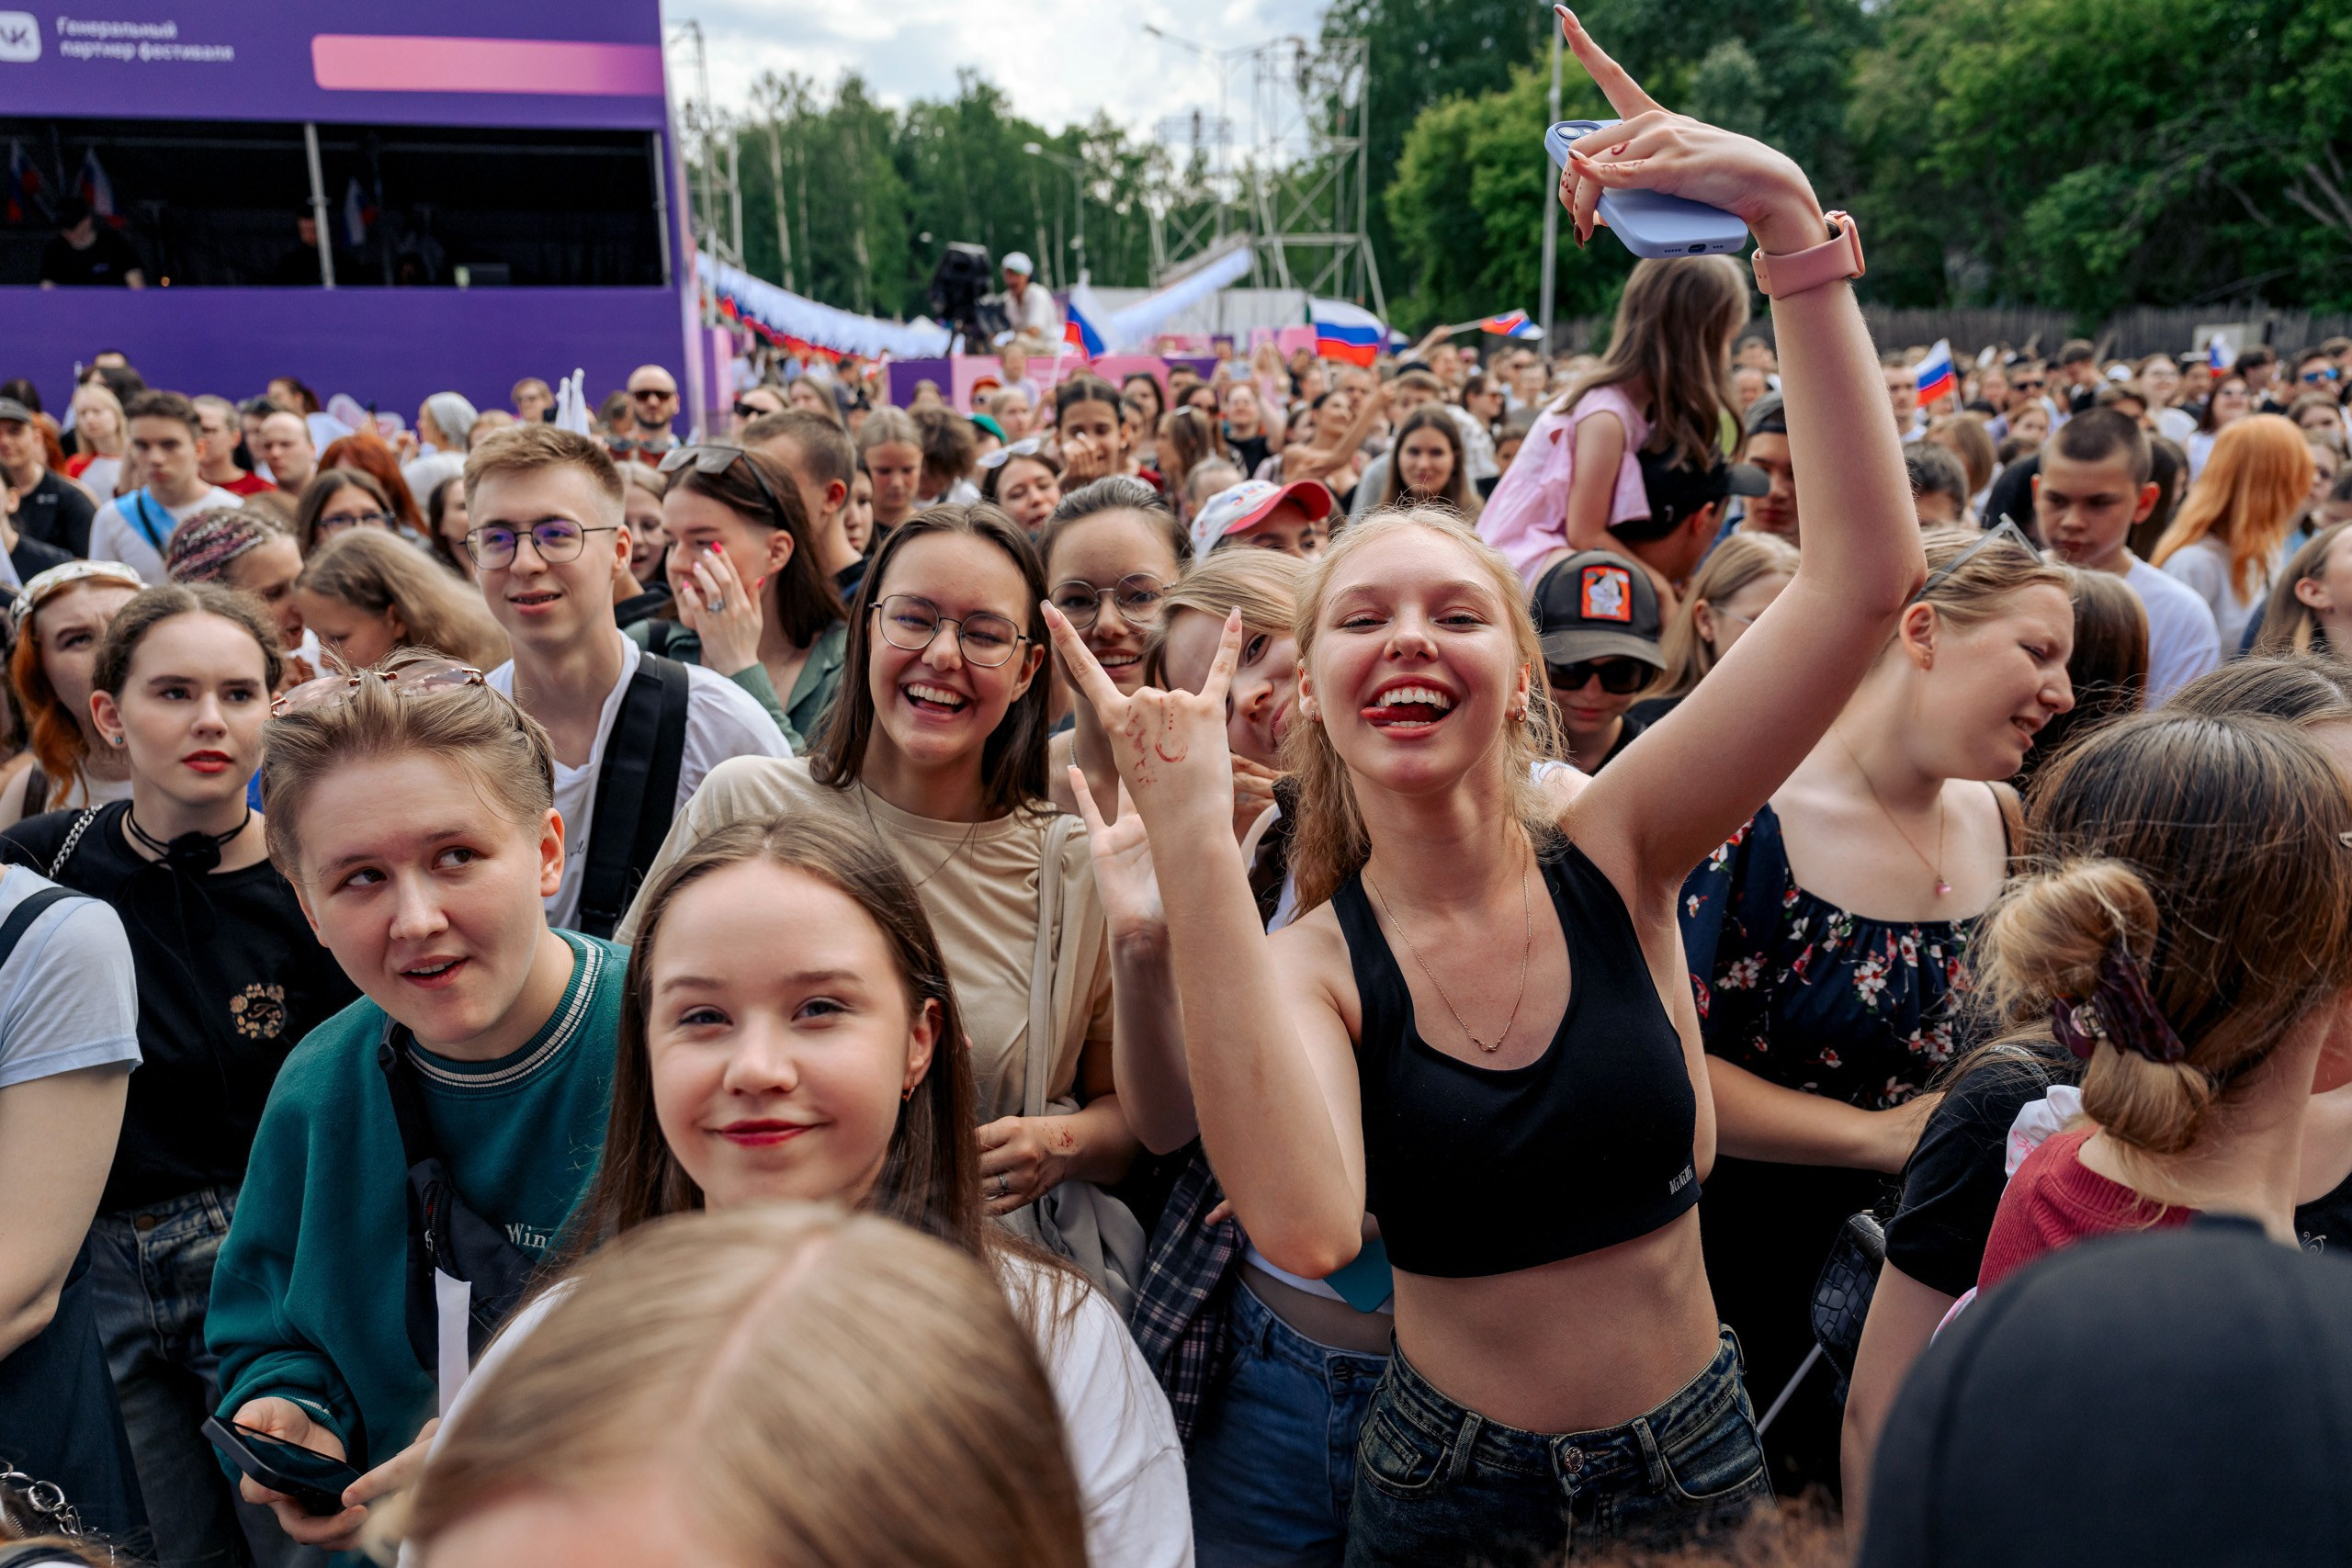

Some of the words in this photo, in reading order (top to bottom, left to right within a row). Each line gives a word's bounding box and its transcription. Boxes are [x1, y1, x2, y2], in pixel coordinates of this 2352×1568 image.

[56, 17, 177, 39] Генеральный
[60, 40, 136, 62] партнер
[138, 41, 234, 62] фестиваля
[504, 1222, 553, 1249] Win
